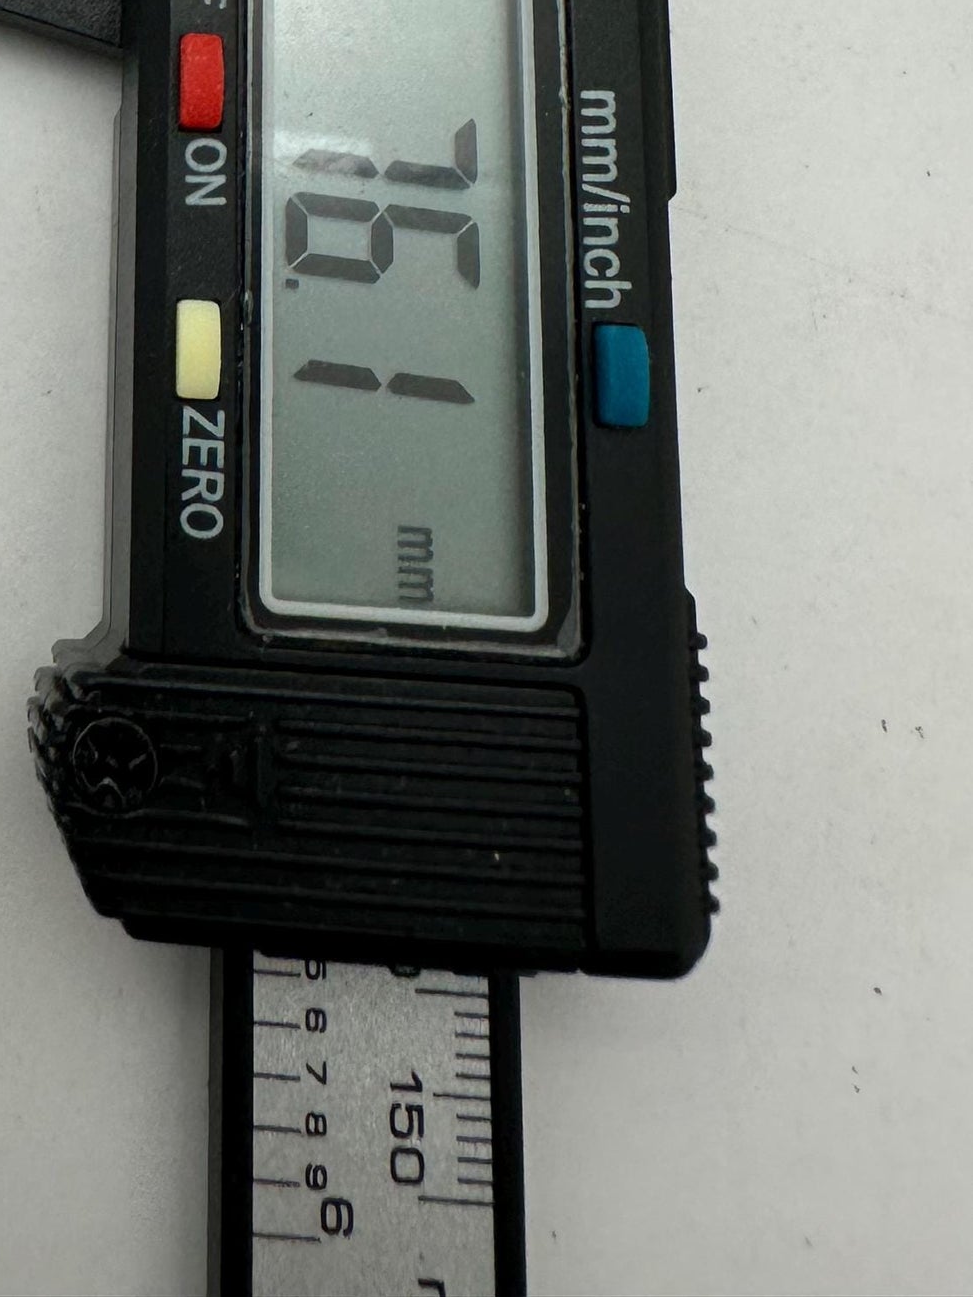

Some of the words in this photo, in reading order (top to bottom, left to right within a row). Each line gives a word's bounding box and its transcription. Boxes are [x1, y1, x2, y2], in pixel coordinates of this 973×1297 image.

[184, 137, 228, 206] ON
[580, 89, 633, 309] mm/inch
[180, 405, 226, 540] ZERO
[397, 524, 434, 603] mm
[305, 1007, 327, 1033] 6
[305, 1061, 327, 1086] 7
[305, 1111, 327, 1137] 8
[390, 1069, 425, 1187] 150
[305, 1163, 327, 1190] 9
[321, 1197, 354, 1239] 6
